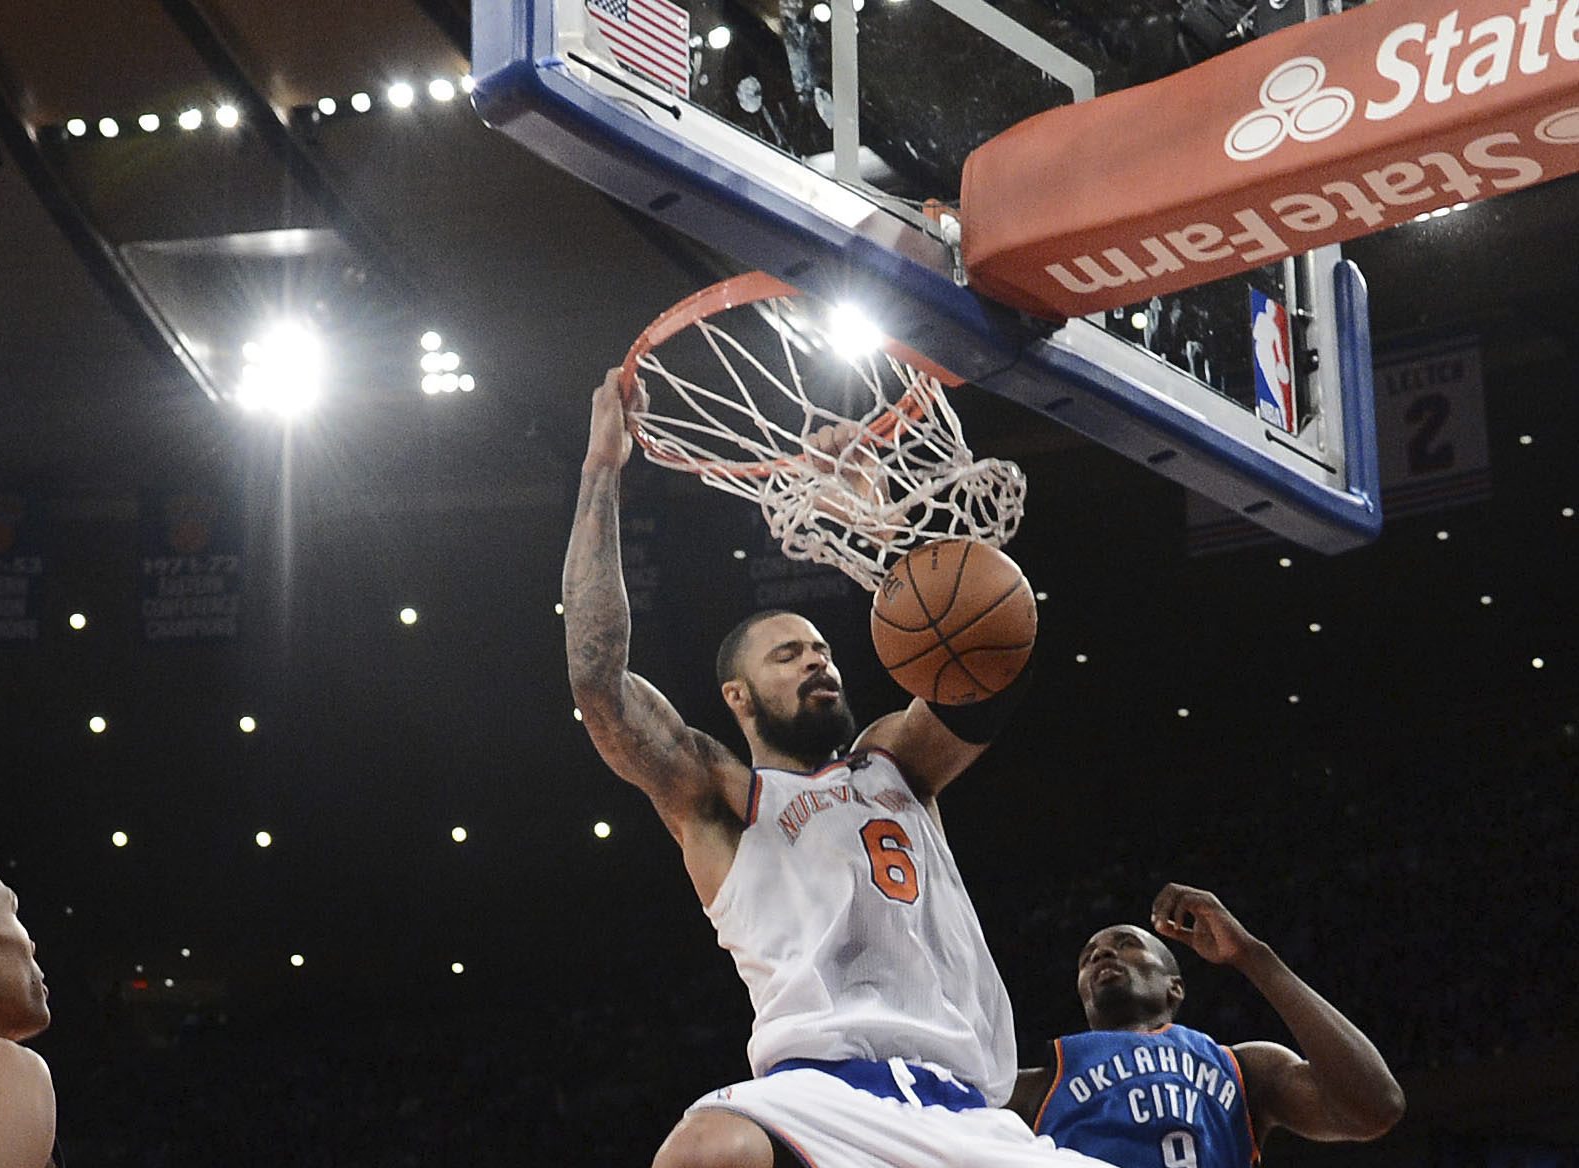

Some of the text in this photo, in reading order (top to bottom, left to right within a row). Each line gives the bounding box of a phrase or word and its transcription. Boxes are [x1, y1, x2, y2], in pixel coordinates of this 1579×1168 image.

[1405, 392, 1455, 472] 2
[859, 818, 920, 906] 6
[1069, 1046, 1236, 1112] OKLAHOMA
[1127, 1083, 1199, 1125] CITY
